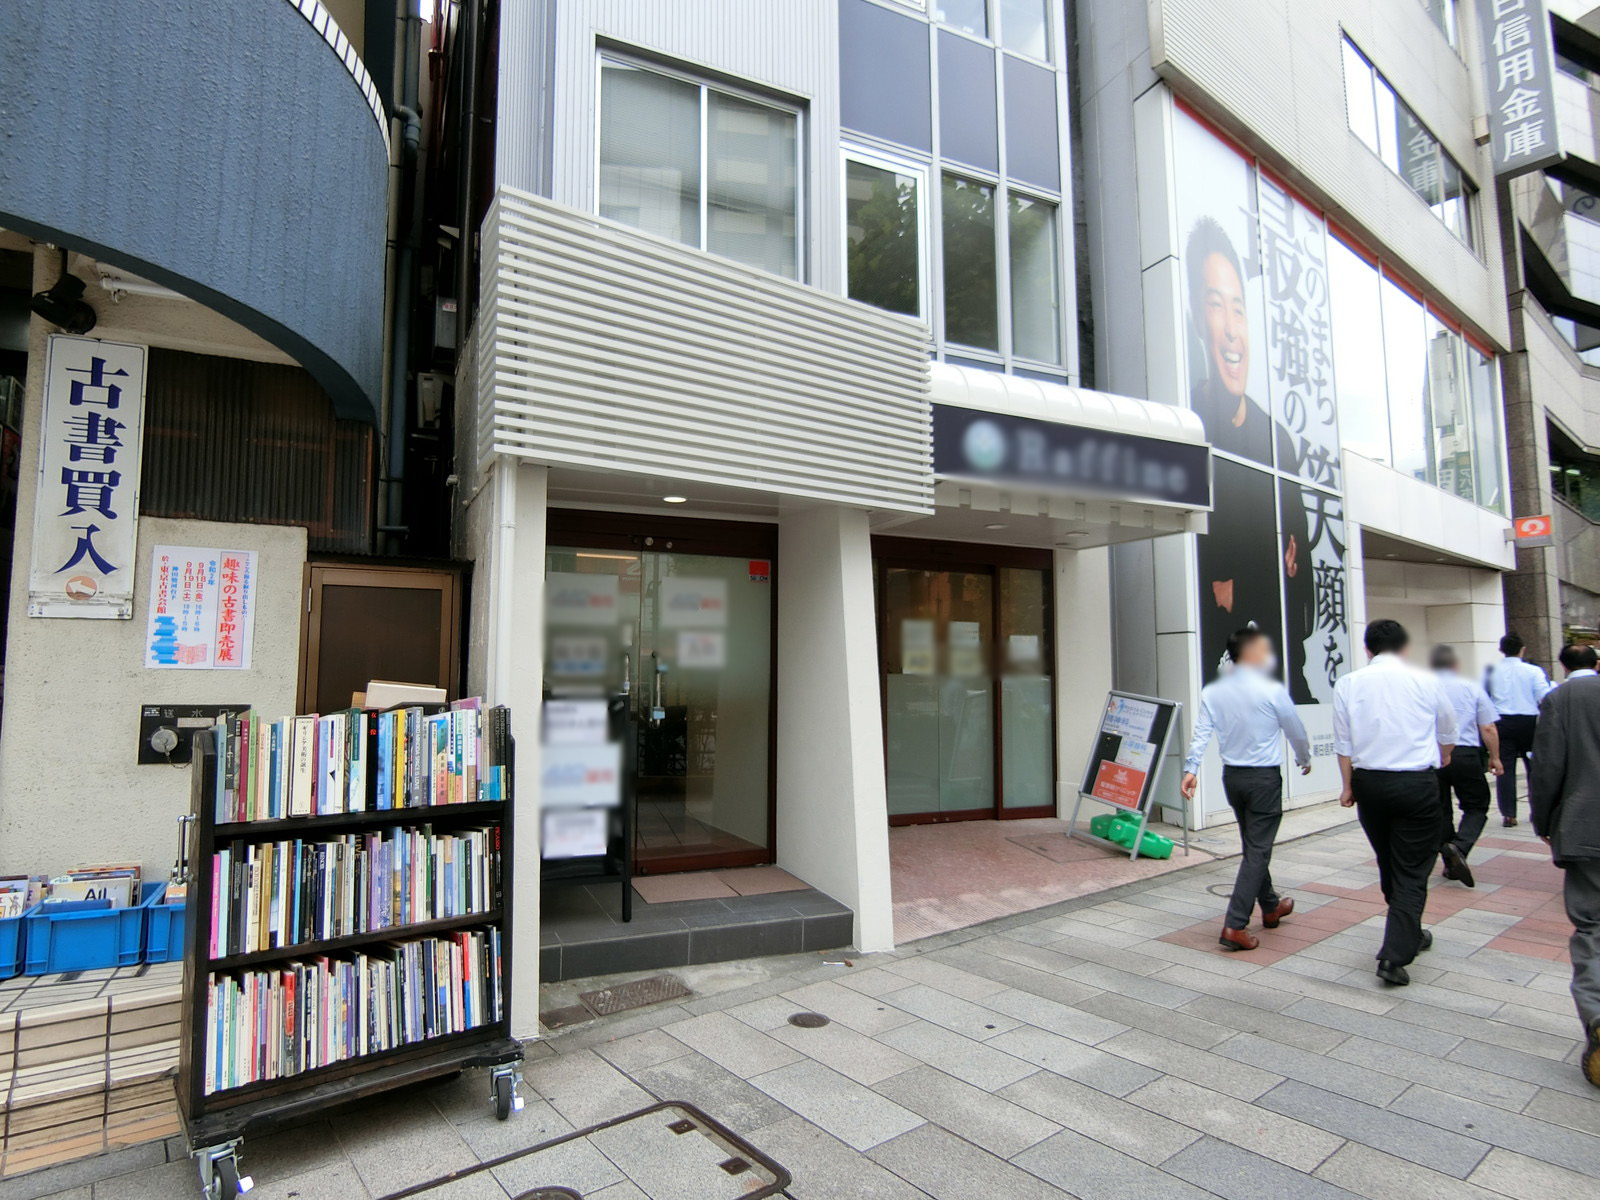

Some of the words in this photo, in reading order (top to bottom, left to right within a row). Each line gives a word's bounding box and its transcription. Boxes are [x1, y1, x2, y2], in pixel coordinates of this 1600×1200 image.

[1304, 213, 1336, 427] このまち
[53, 356, 130, 575] 古書買入
[217, 557, 241, 662] 趣味の古書即売展
